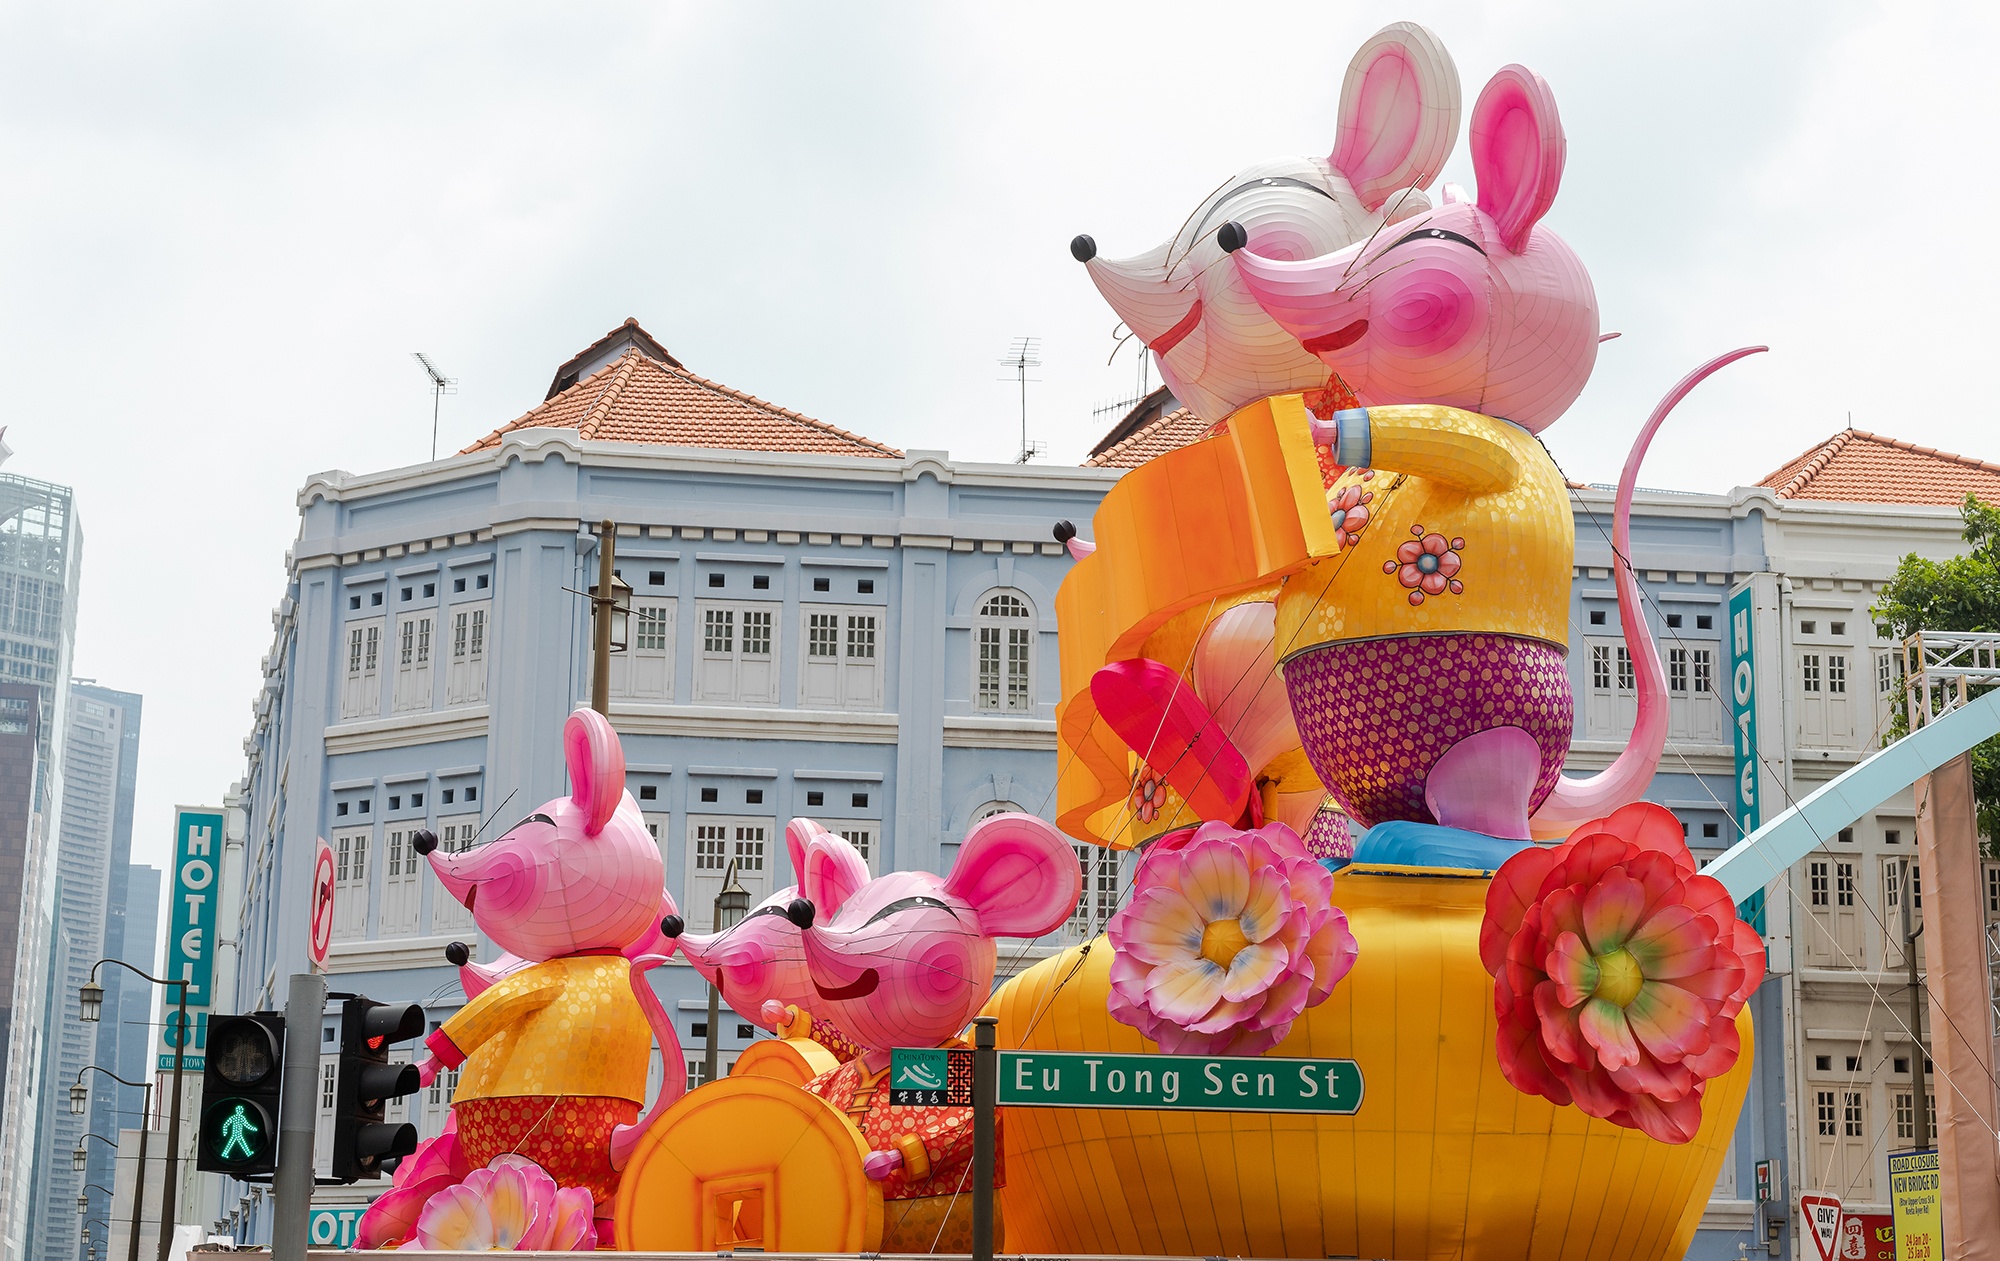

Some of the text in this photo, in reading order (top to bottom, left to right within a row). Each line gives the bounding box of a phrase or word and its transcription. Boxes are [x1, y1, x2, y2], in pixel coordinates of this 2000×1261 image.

[181, 825, 213, 994] HOTEL
[164, 1010, 207, 1049] 81
[1015, 1058, 1339, 1103] Eu Tong Sen St
[1892, 1154, 1938, 1171] ROAD CLOSURE
[1894, 1173, 1939, 1193] NEW BRIDGE RD
[1817, 1207, 1835, 1224] GIVE
[1821, 1227, 1833, 1239] WAY
[1906, 1234, 1912, 1246] 24
[1912, 1234, 1922, 1246] Jan
[1922, 1233, 1929, 1245] 20
[1908, 1245, 1931, 1259] 25 Jan 20
